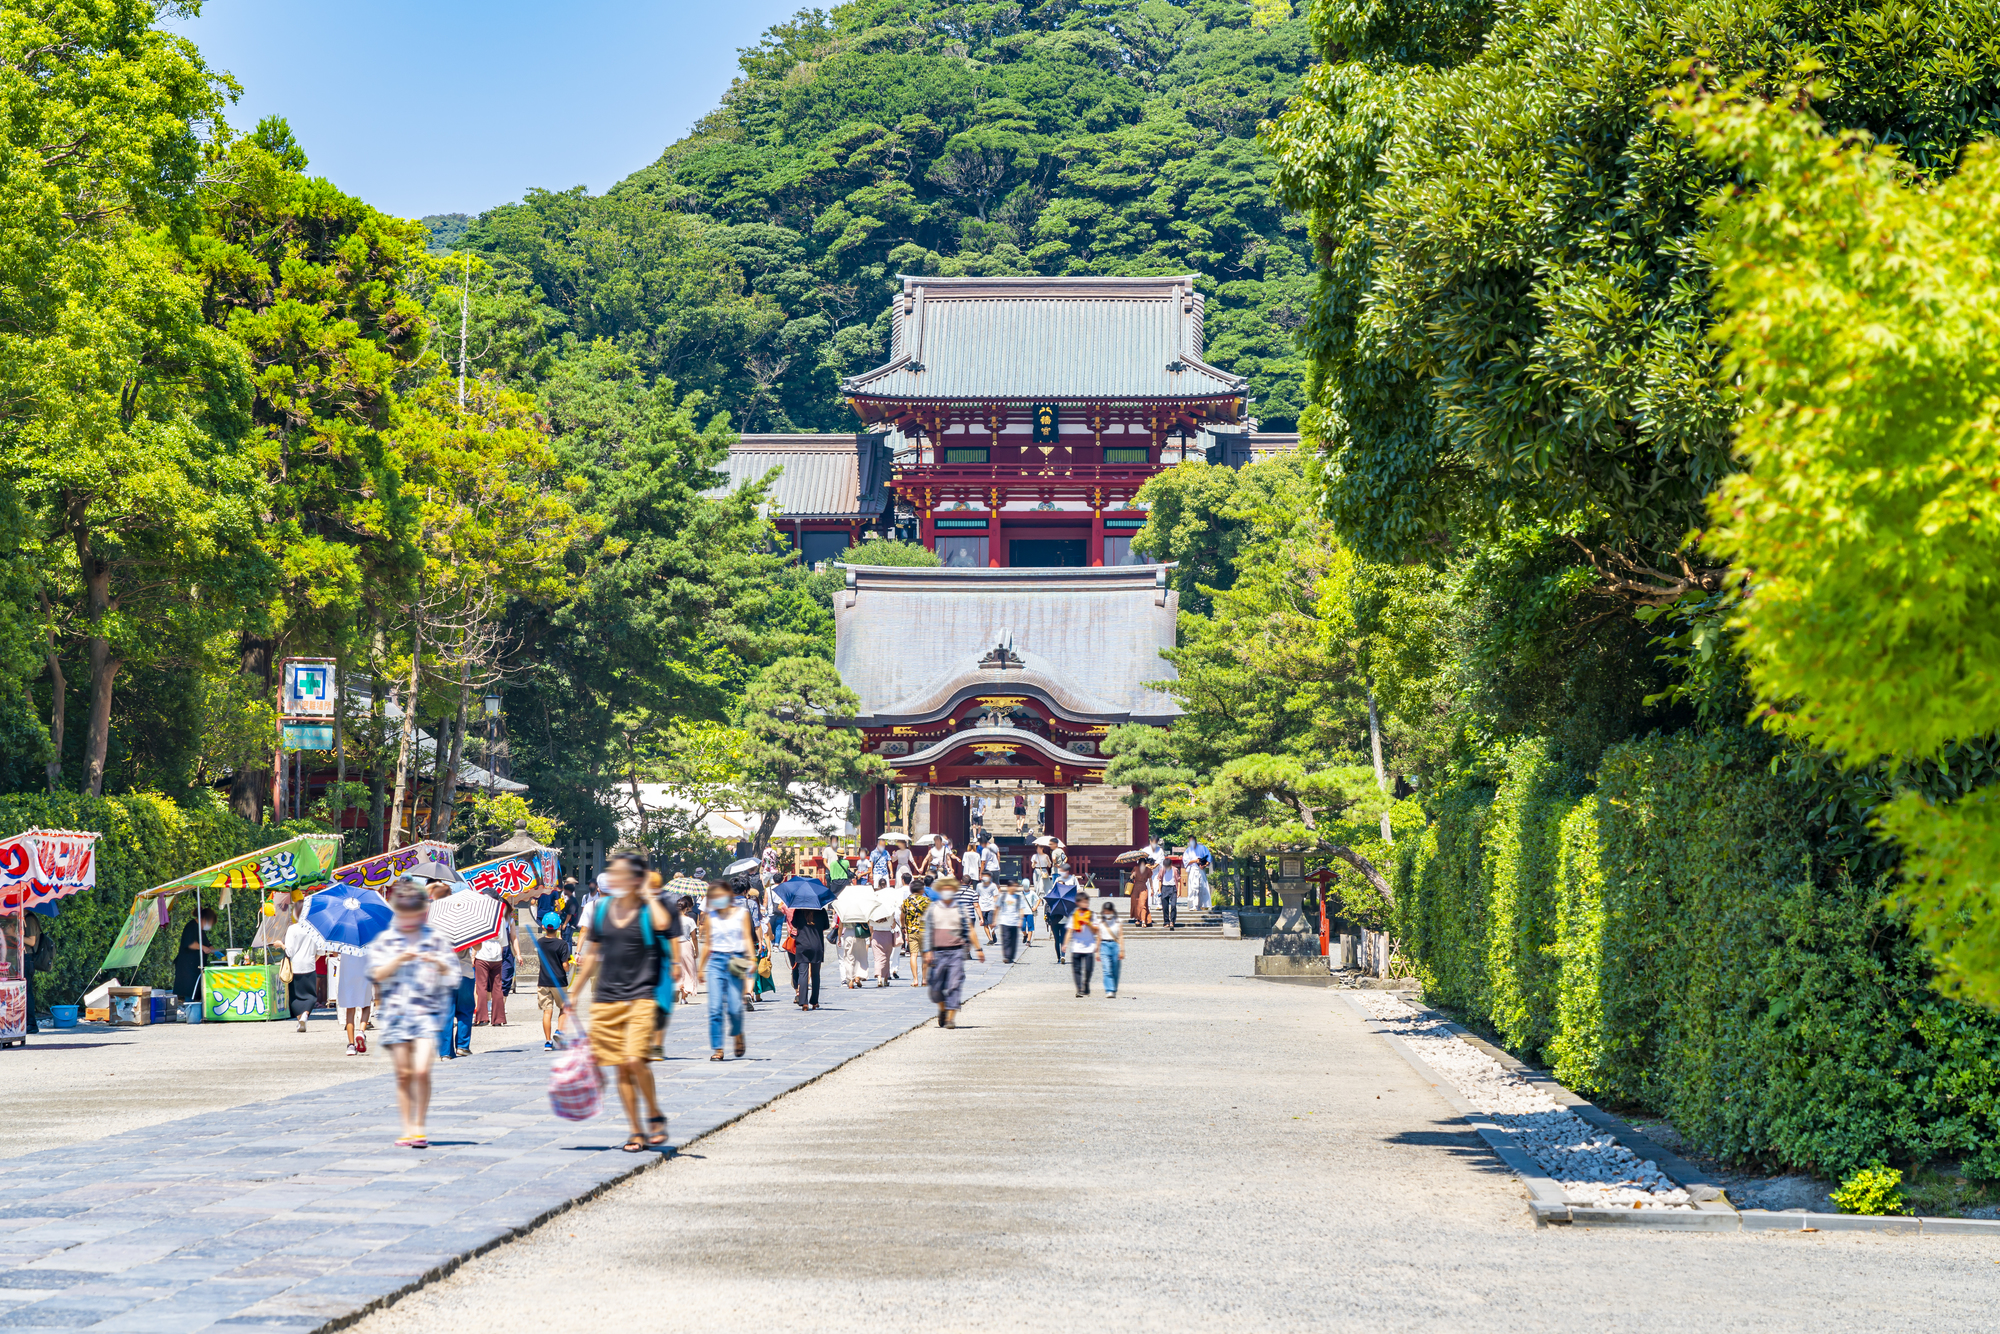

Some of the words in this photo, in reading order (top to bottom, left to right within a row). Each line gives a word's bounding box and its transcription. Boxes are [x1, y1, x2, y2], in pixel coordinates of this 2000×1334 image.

[1038, 406, 1053, 436] 八幡宮
[467, 860, 533, 894] き氷
